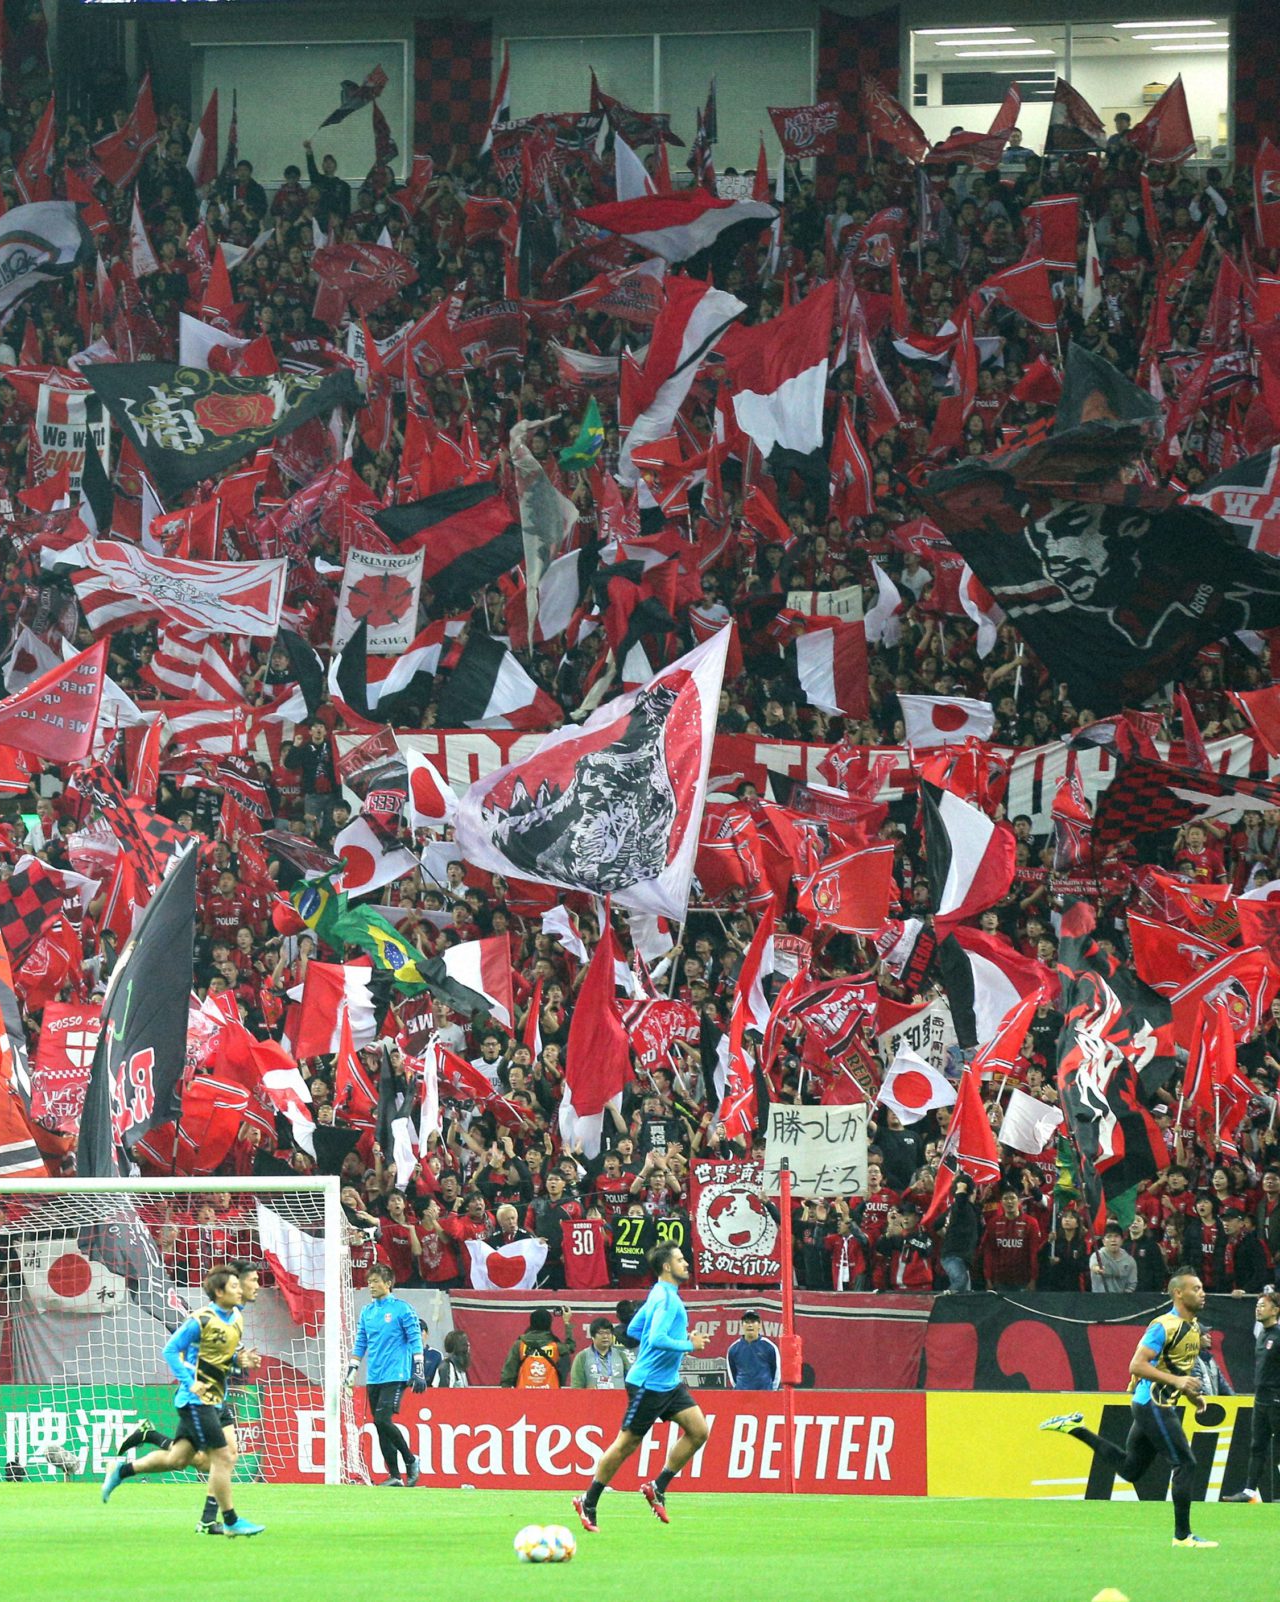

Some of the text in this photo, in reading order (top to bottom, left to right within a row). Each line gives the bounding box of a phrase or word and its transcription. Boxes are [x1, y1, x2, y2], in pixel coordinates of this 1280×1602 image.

[43, 425, 105, 448] We wnt
[1189, 583, 1214, 615] BOYS
[48, 1015, 83, 1033] ROSSO
[773, 1110, 864, 1146] 勝つしか
[572, 1229, 594, 1256] 30
[617, 1219, 644, 1246] 27
[656, 1221, 684, 1248] 30
[996, 1238, 1023, 1249] POLUS
[615, 1246, 645, 1255] HASHIOKA
[695, 1320, 721, 1337] OF
[726, 1415, 896, 1482] BETTER
